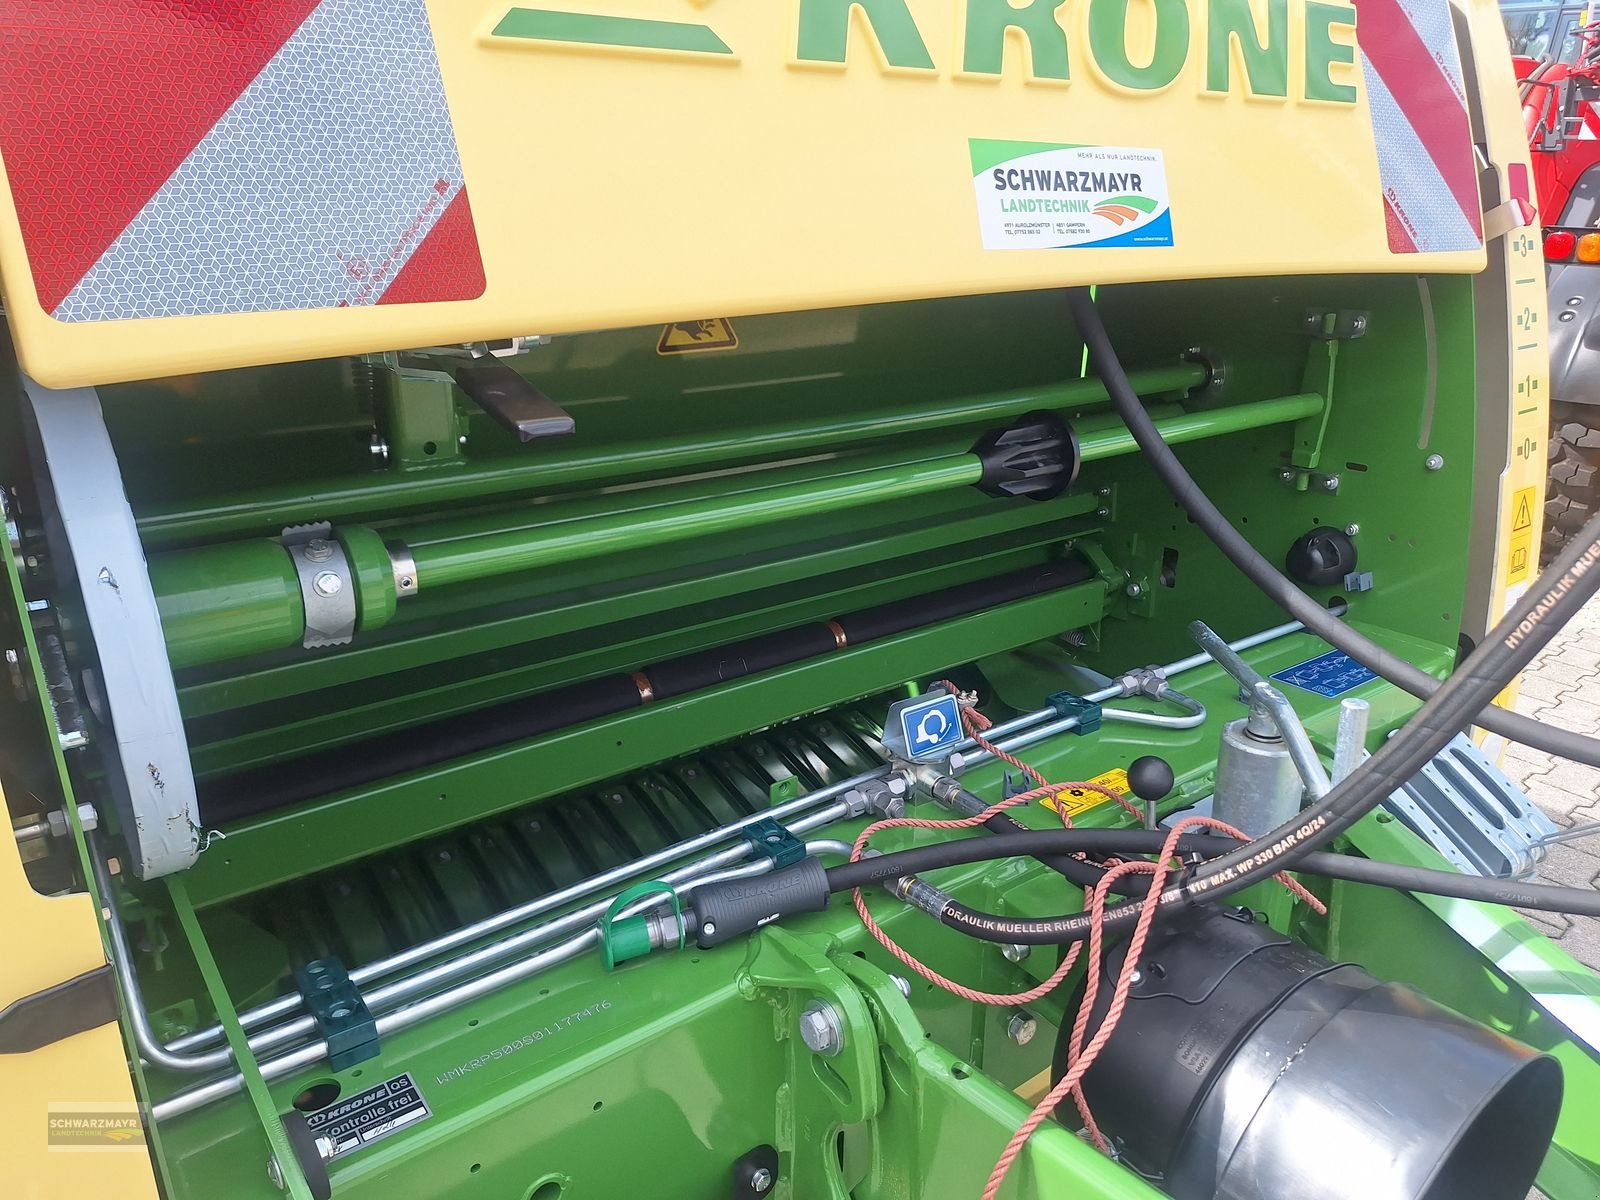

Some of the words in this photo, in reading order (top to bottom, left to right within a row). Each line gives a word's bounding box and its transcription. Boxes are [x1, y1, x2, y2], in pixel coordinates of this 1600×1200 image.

[993, 168, 1143, 193] SCHWARZMAYR
[1000, 198, 1091, 213] LANDTECHNIK
[1519, 234, 1528, 258] 3
[1523, 307, 1531, 330] 2
[1525, 375, 1531, 397] 1
[1523, 437, 1531, 460] 0
[1504, 573, 1576, 650] HYDRAULIK
[1570, 540, 1600, 578] MUE
[942, 905, 995, 930] YDRAULIK
[996, 922, 1052, 933] MUELLER
[1053, 914, 1093, 932] RHEIN
[1102, 904, 1135, 922] EN853
[1210, 868, 1238, 887] MAX.
[1236, 858, 1254, 875] WP
[1254, 848, 1274, 866] 330
[1272, 834, 1298, 855] BAR
[1296, 815, 1326, 840] 4Q/24
[324, 1087, 387, 1120] KRONE
[390, 1078, 409, 1091] QS
[326, 1105, 386, 1136] ontrolle
[388, 1092, 413, 1110] frei
